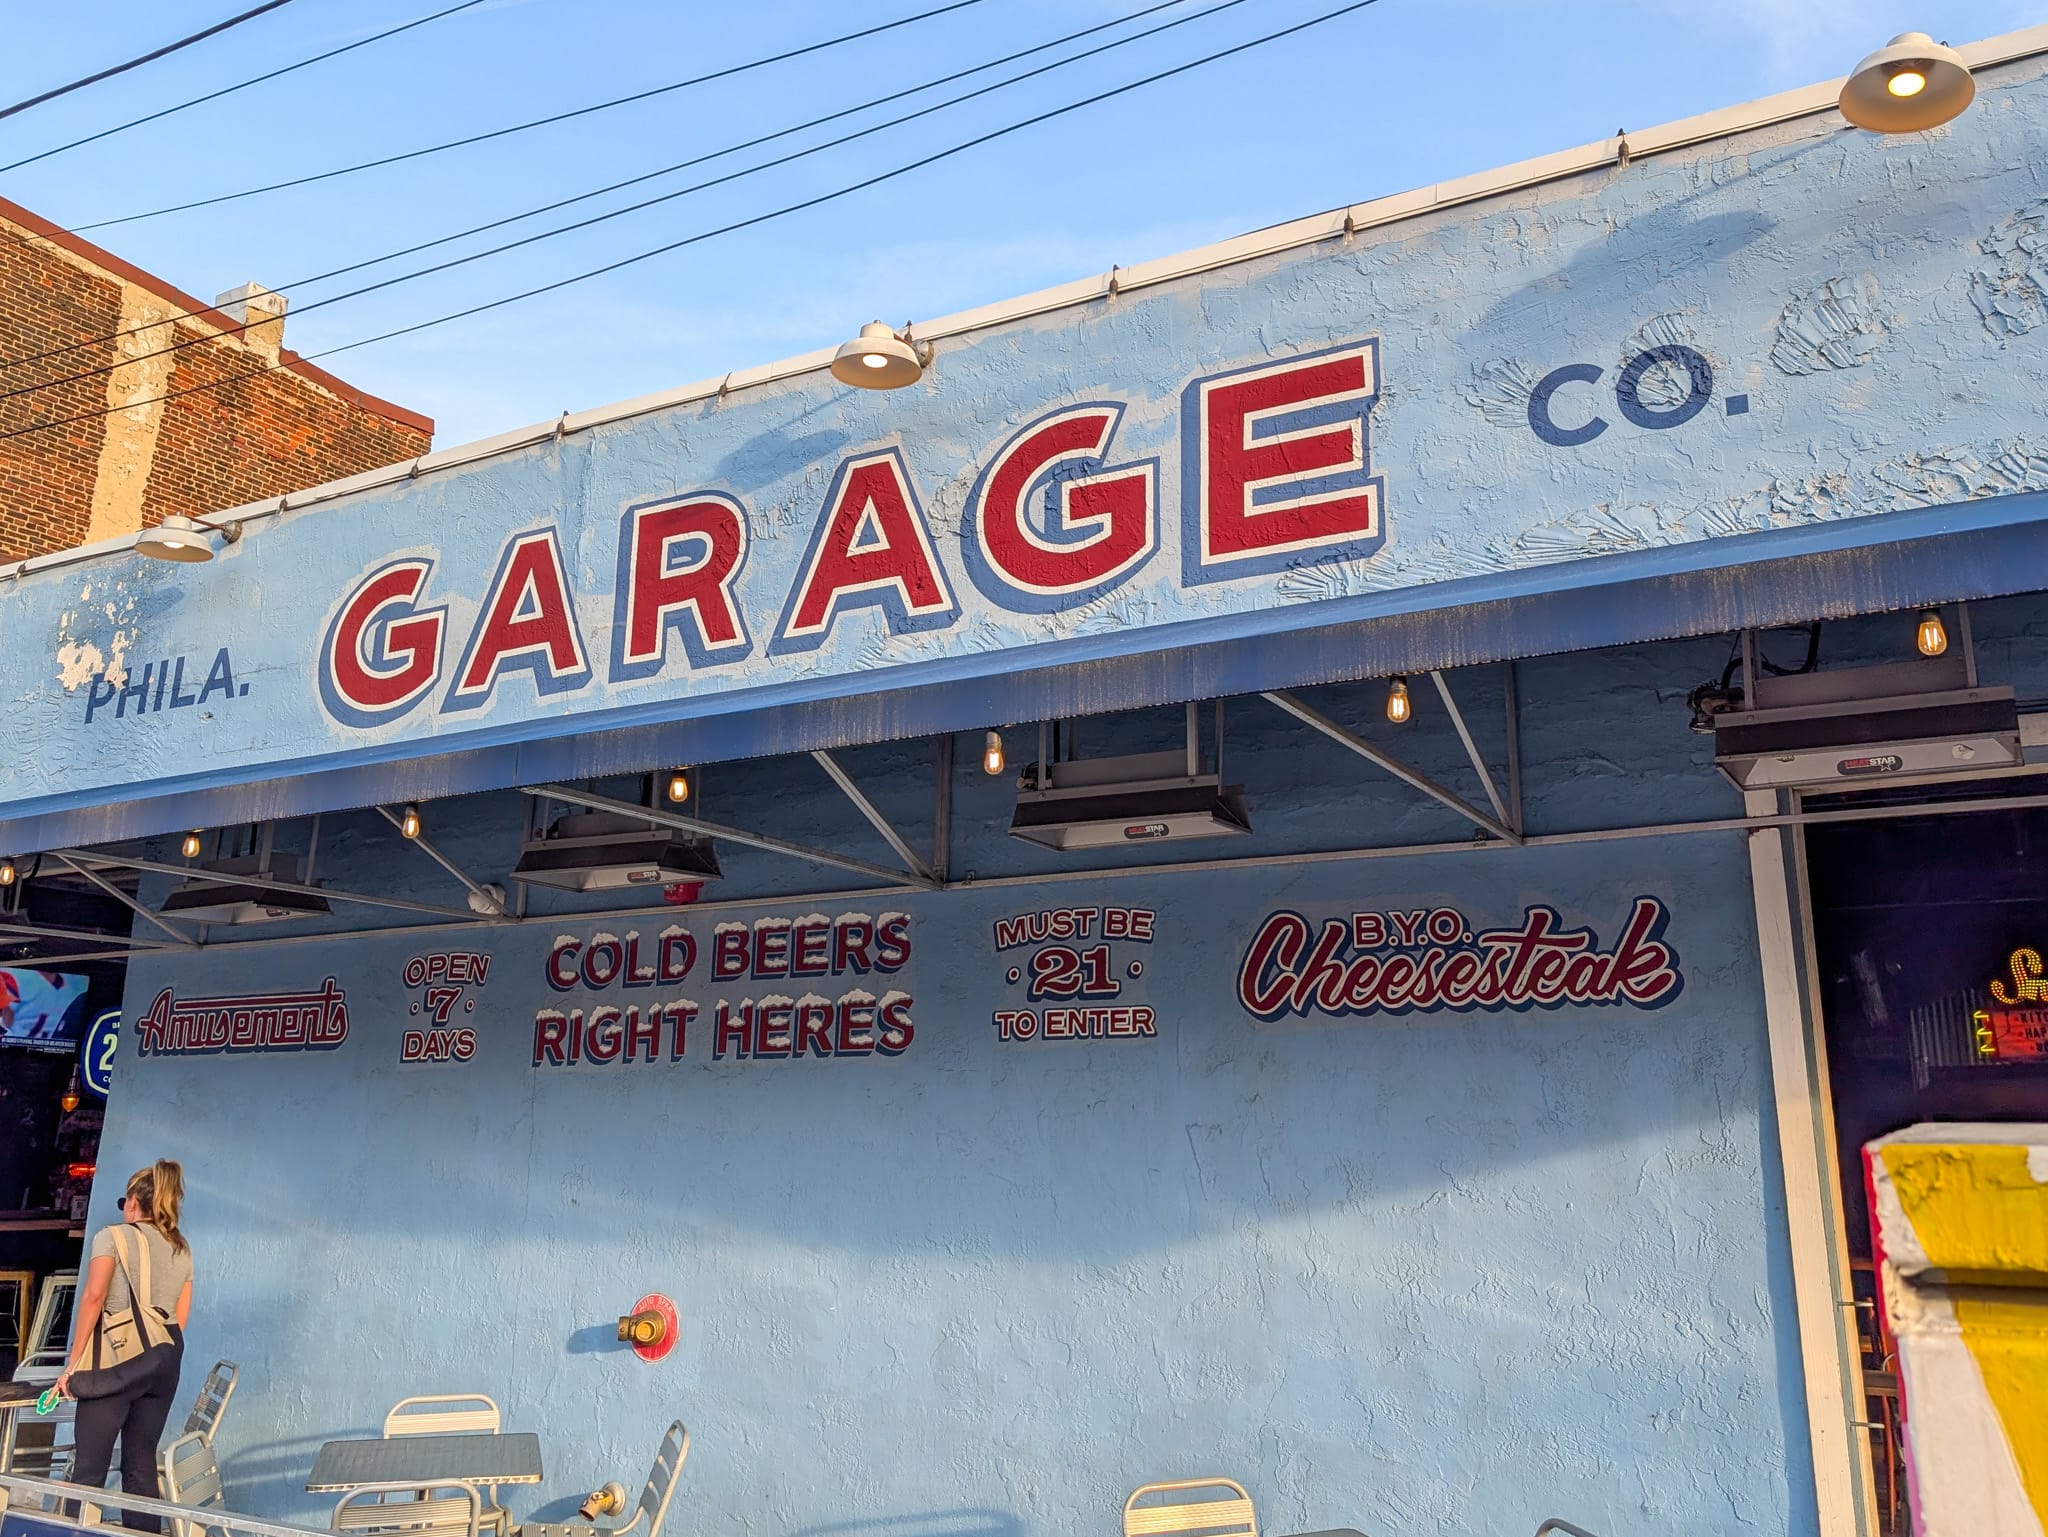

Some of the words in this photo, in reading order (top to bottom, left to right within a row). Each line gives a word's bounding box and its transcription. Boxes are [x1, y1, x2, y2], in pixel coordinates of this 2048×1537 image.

[84, 647, 250, 724] PHILA.
[319, 337, 1387, 728] GARAGE
[1527, 344, 1750, 447] CO.
[546, 923, 698, 993] COLD
[710, 911, 912, 983] BEERS
[994, 907, 1098, 953] MUST
[1101, 906, 1156, 941] BE
[1351, 907, 1474, 949] B.Y.O.
[403, 952, 492, 986] OPEN
[1028, 944, 1123, 1002] 21
[1237, 895, 1685, 1023] Cheesesteak
[136, 976, 350, 1057] Amusements
[424, 987, 464, 1026] 7
[532, 998, 699, 1068] RIGHT
[712, 988, 915, 1061] HERES
[994, 1008, 1038, 1042] TO
[1042, 1006, 1157, 1039] ENTER
[400, 1028, 477, 1064] DAYS
